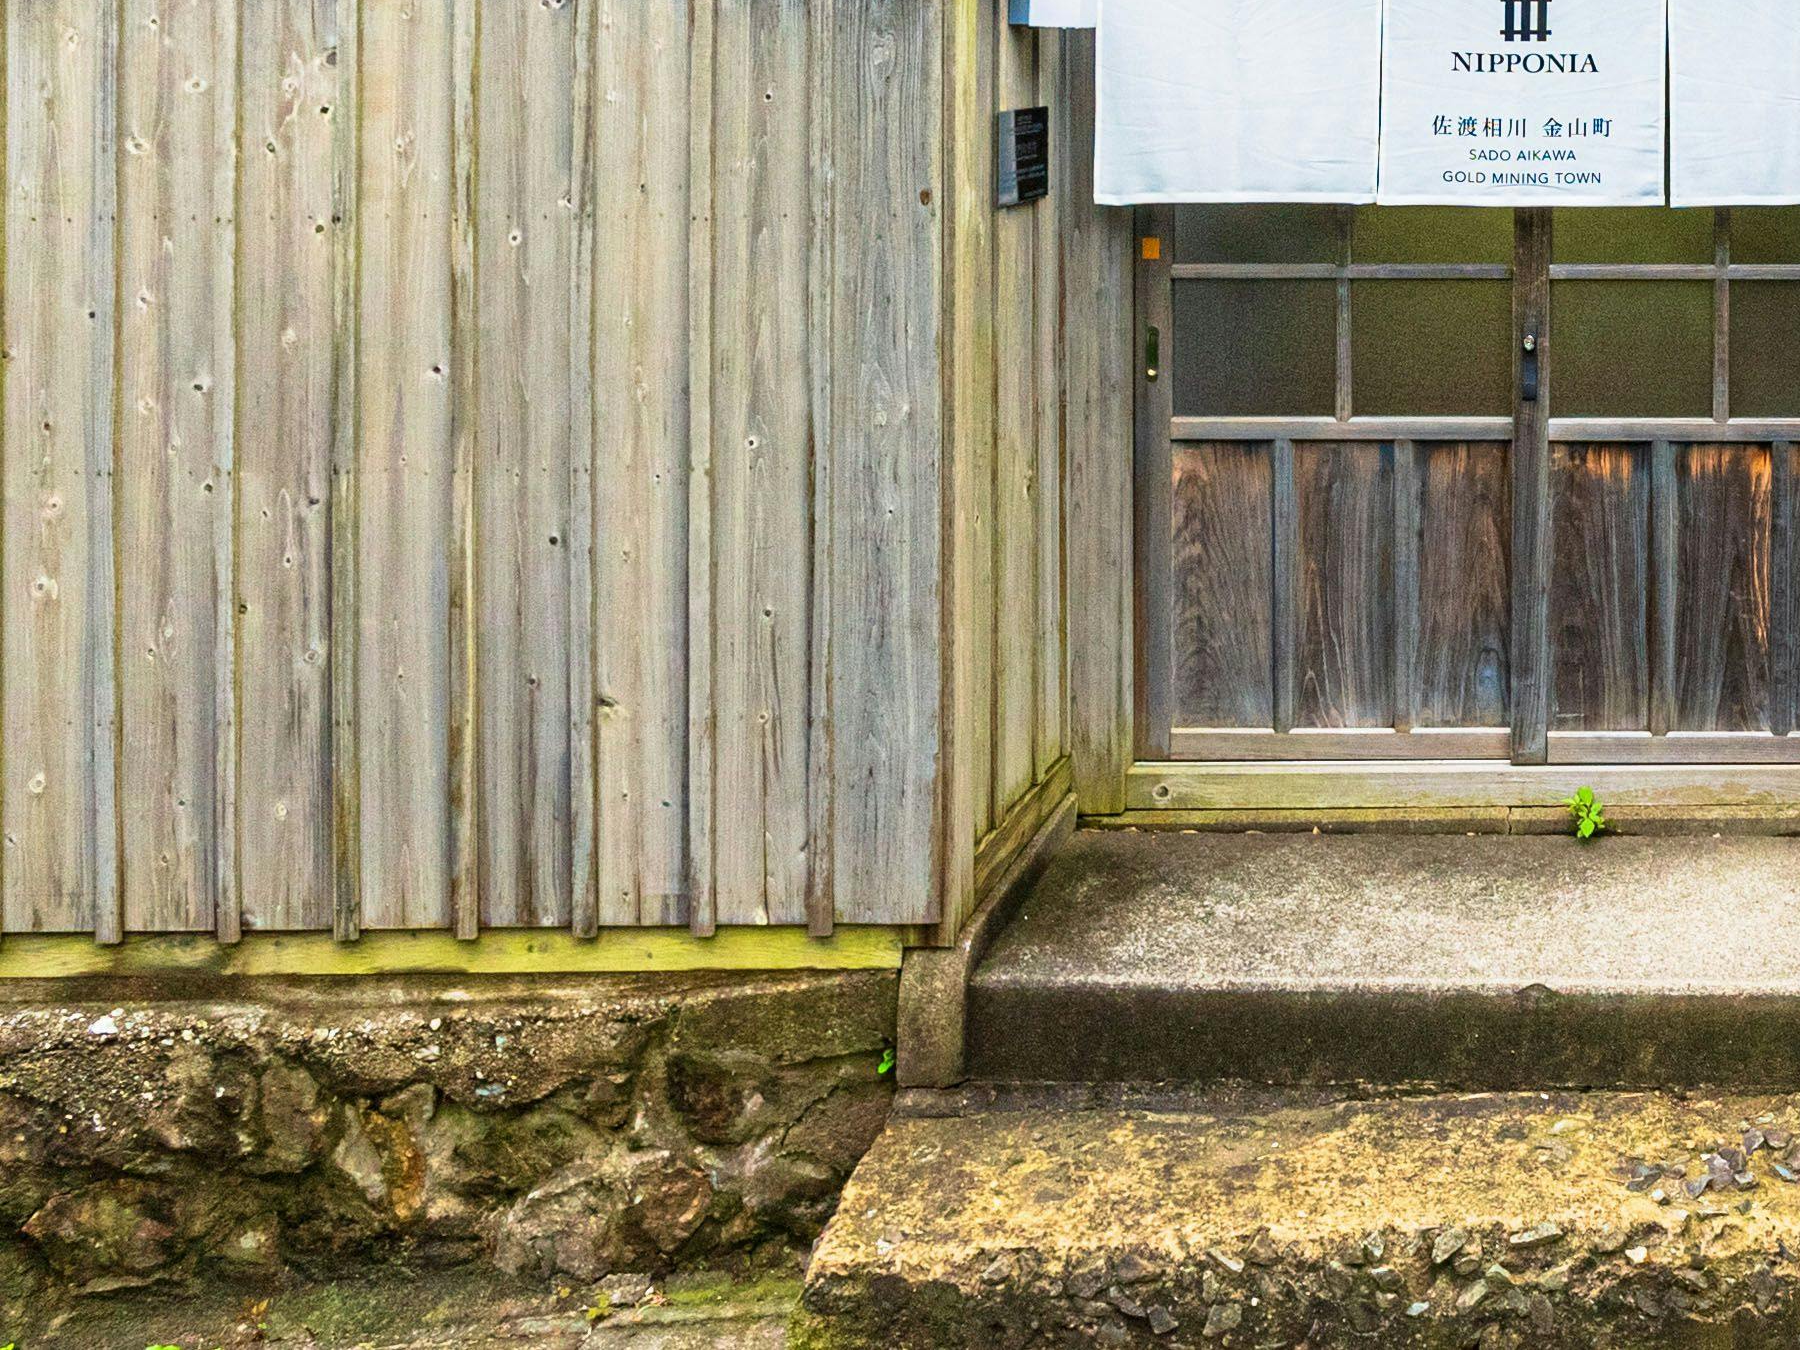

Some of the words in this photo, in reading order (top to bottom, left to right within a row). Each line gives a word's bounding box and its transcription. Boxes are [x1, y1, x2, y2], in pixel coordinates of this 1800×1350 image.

[1450, 51, 1600, 74] NIPPONIA
[1431, 114, 1527, 138] 佐渡相川
[1542, 116, 1613, 138] 金山町
[1469, 148, 1511, 162] SADO
[1516, 149, 1577, 162] AIKAWA
[1442, 170, 1486, 184] GOLD
[1492, 172, 1549, 185] MINING
[1555, 172, 1601, 185] TOWN
